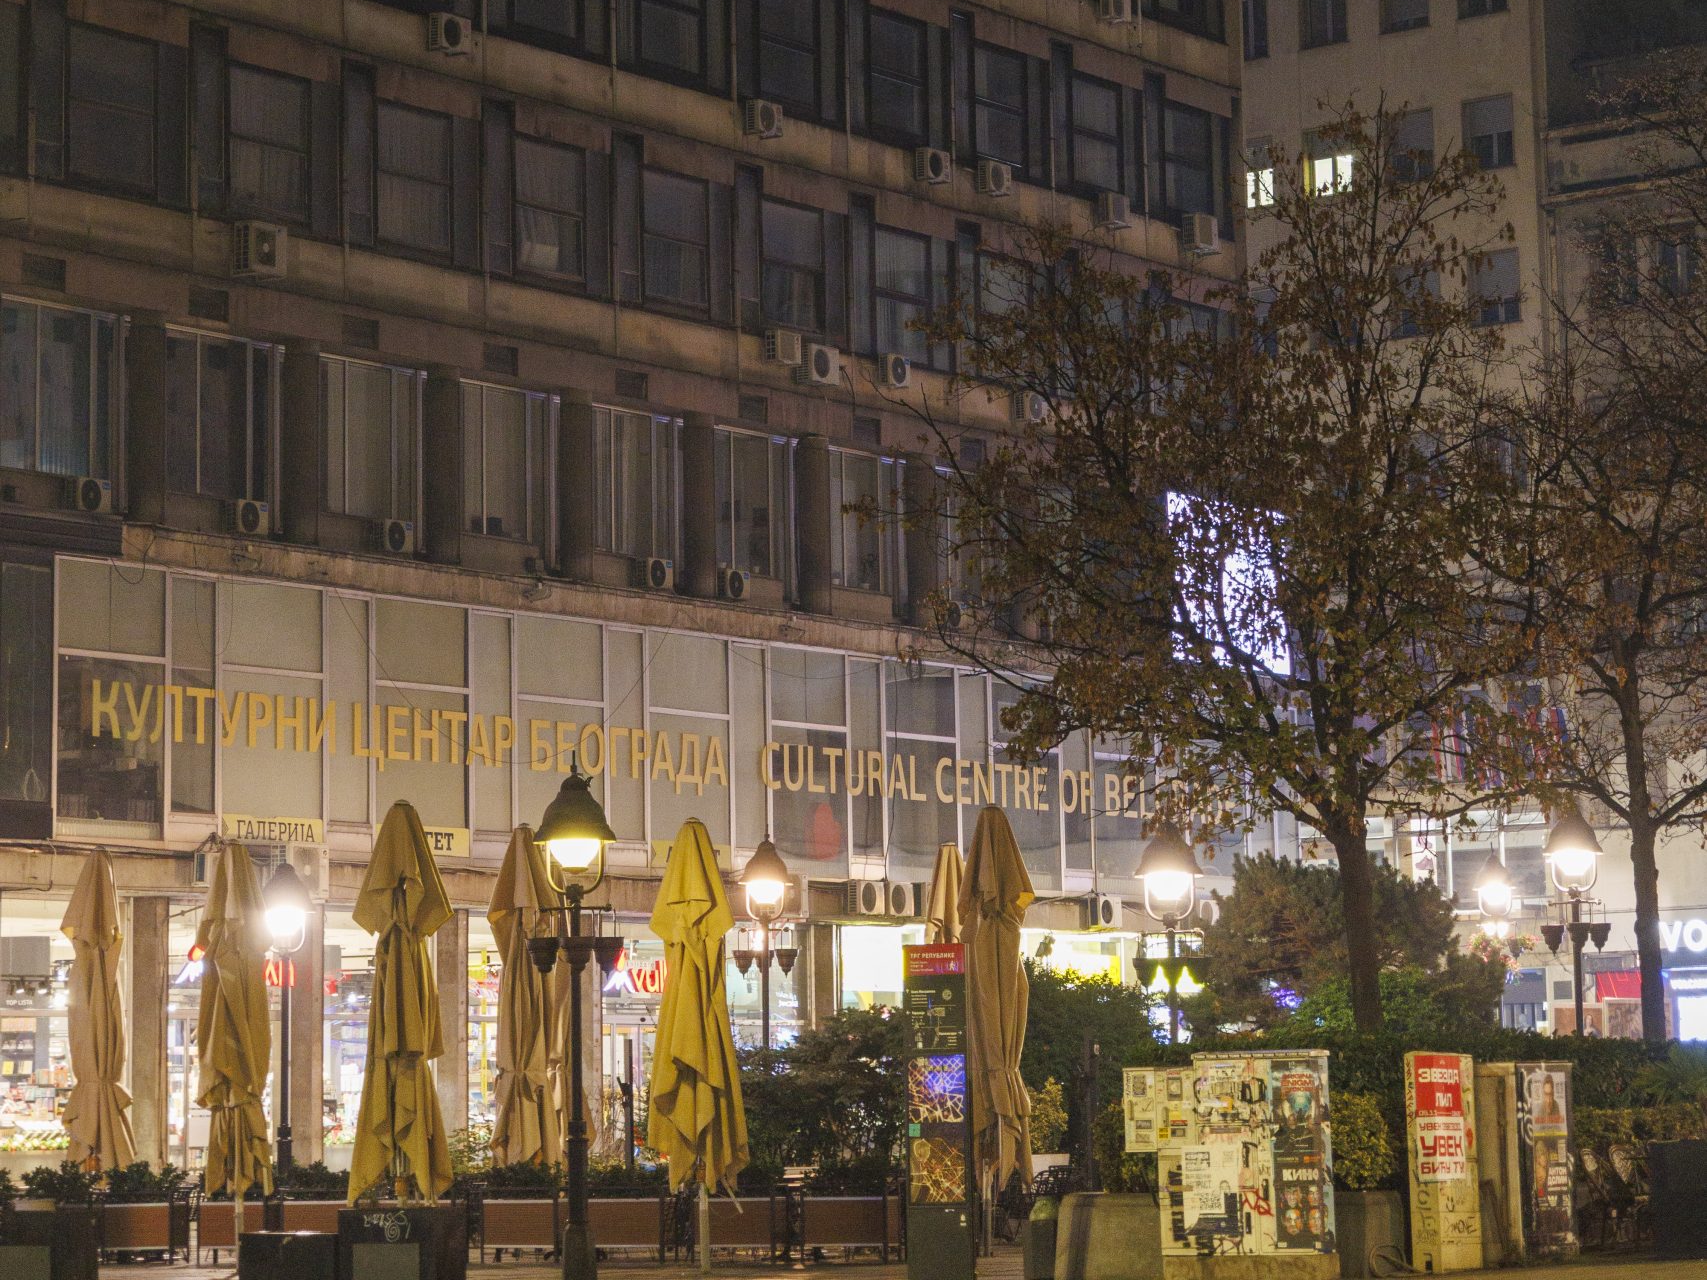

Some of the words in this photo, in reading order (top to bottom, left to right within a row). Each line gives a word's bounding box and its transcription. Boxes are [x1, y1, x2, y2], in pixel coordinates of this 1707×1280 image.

[92, 679, 337, 754] КУЛТУРНИ
[352, 703, 517, 772] ЦЕНТАР
[529, 718, 728, 796] БЕОГРАДА
[761, 741, 927, 801] CULTURAL
[935, 757, 1050, 811] CENTRE
[1061, 769, 1094, 815] OF
[1420, 1135, 1464, 1157] УВЕК
